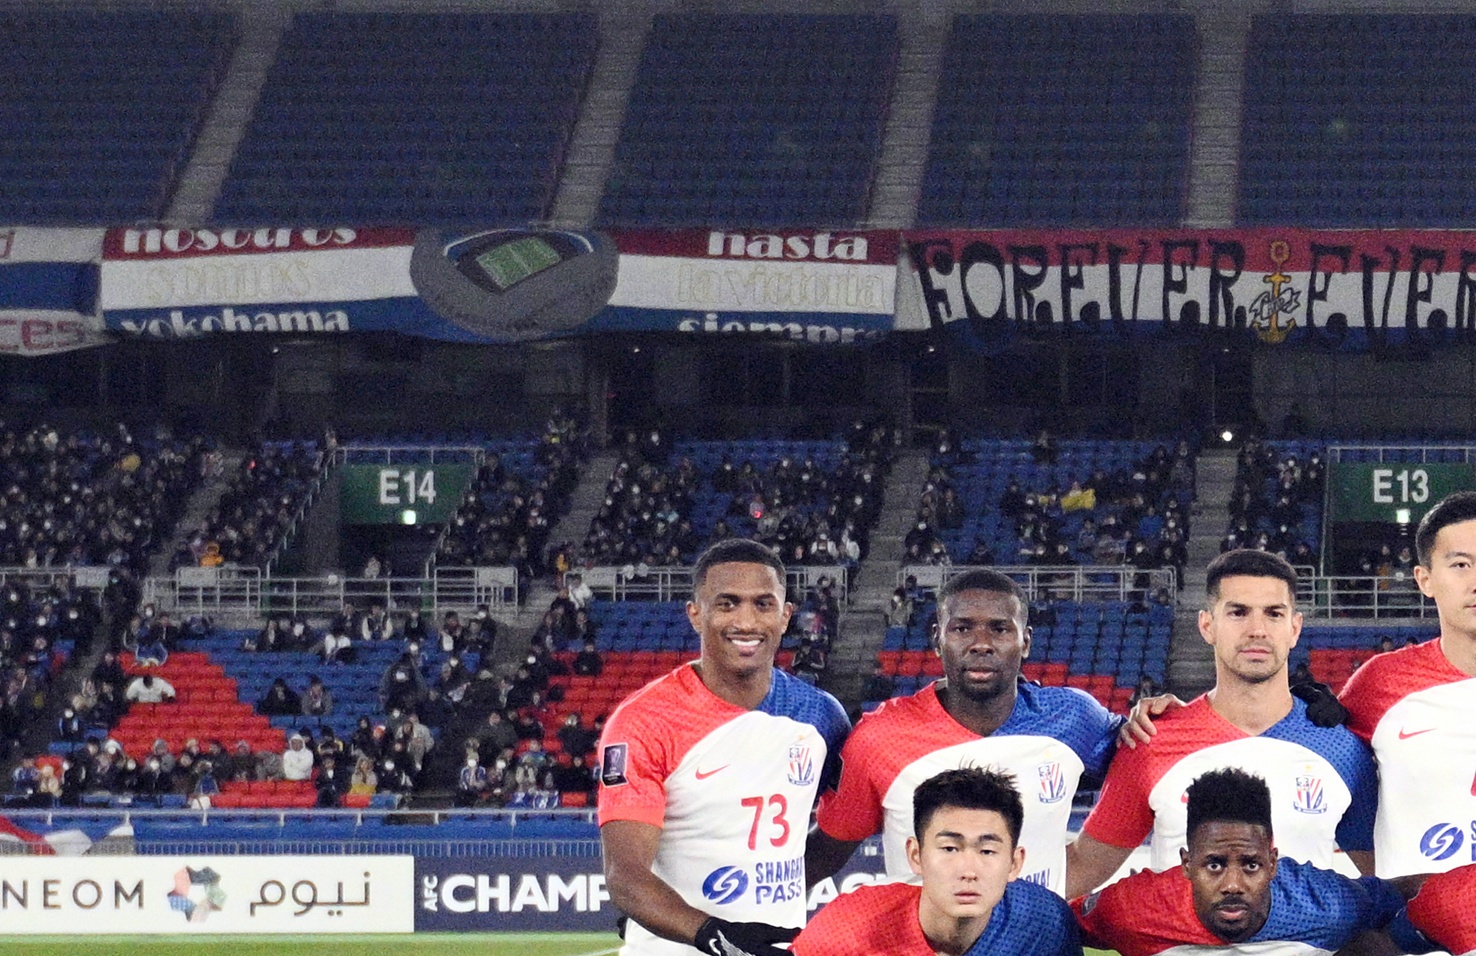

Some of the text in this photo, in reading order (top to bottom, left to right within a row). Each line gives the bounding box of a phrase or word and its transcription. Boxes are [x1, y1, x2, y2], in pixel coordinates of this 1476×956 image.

[908, 239, 1247, 332] FOREVER
[379, 469, 437, 505] E14
[1373, 469, 1429, 503] E13
[741, 794, 790, 851] 73
[2, 878, 145, 910] NEOM
[249, 871, 371, 917] نيوم
[423, 874, 439, 912] AFC
[755, 879, 803, 905] PASS
